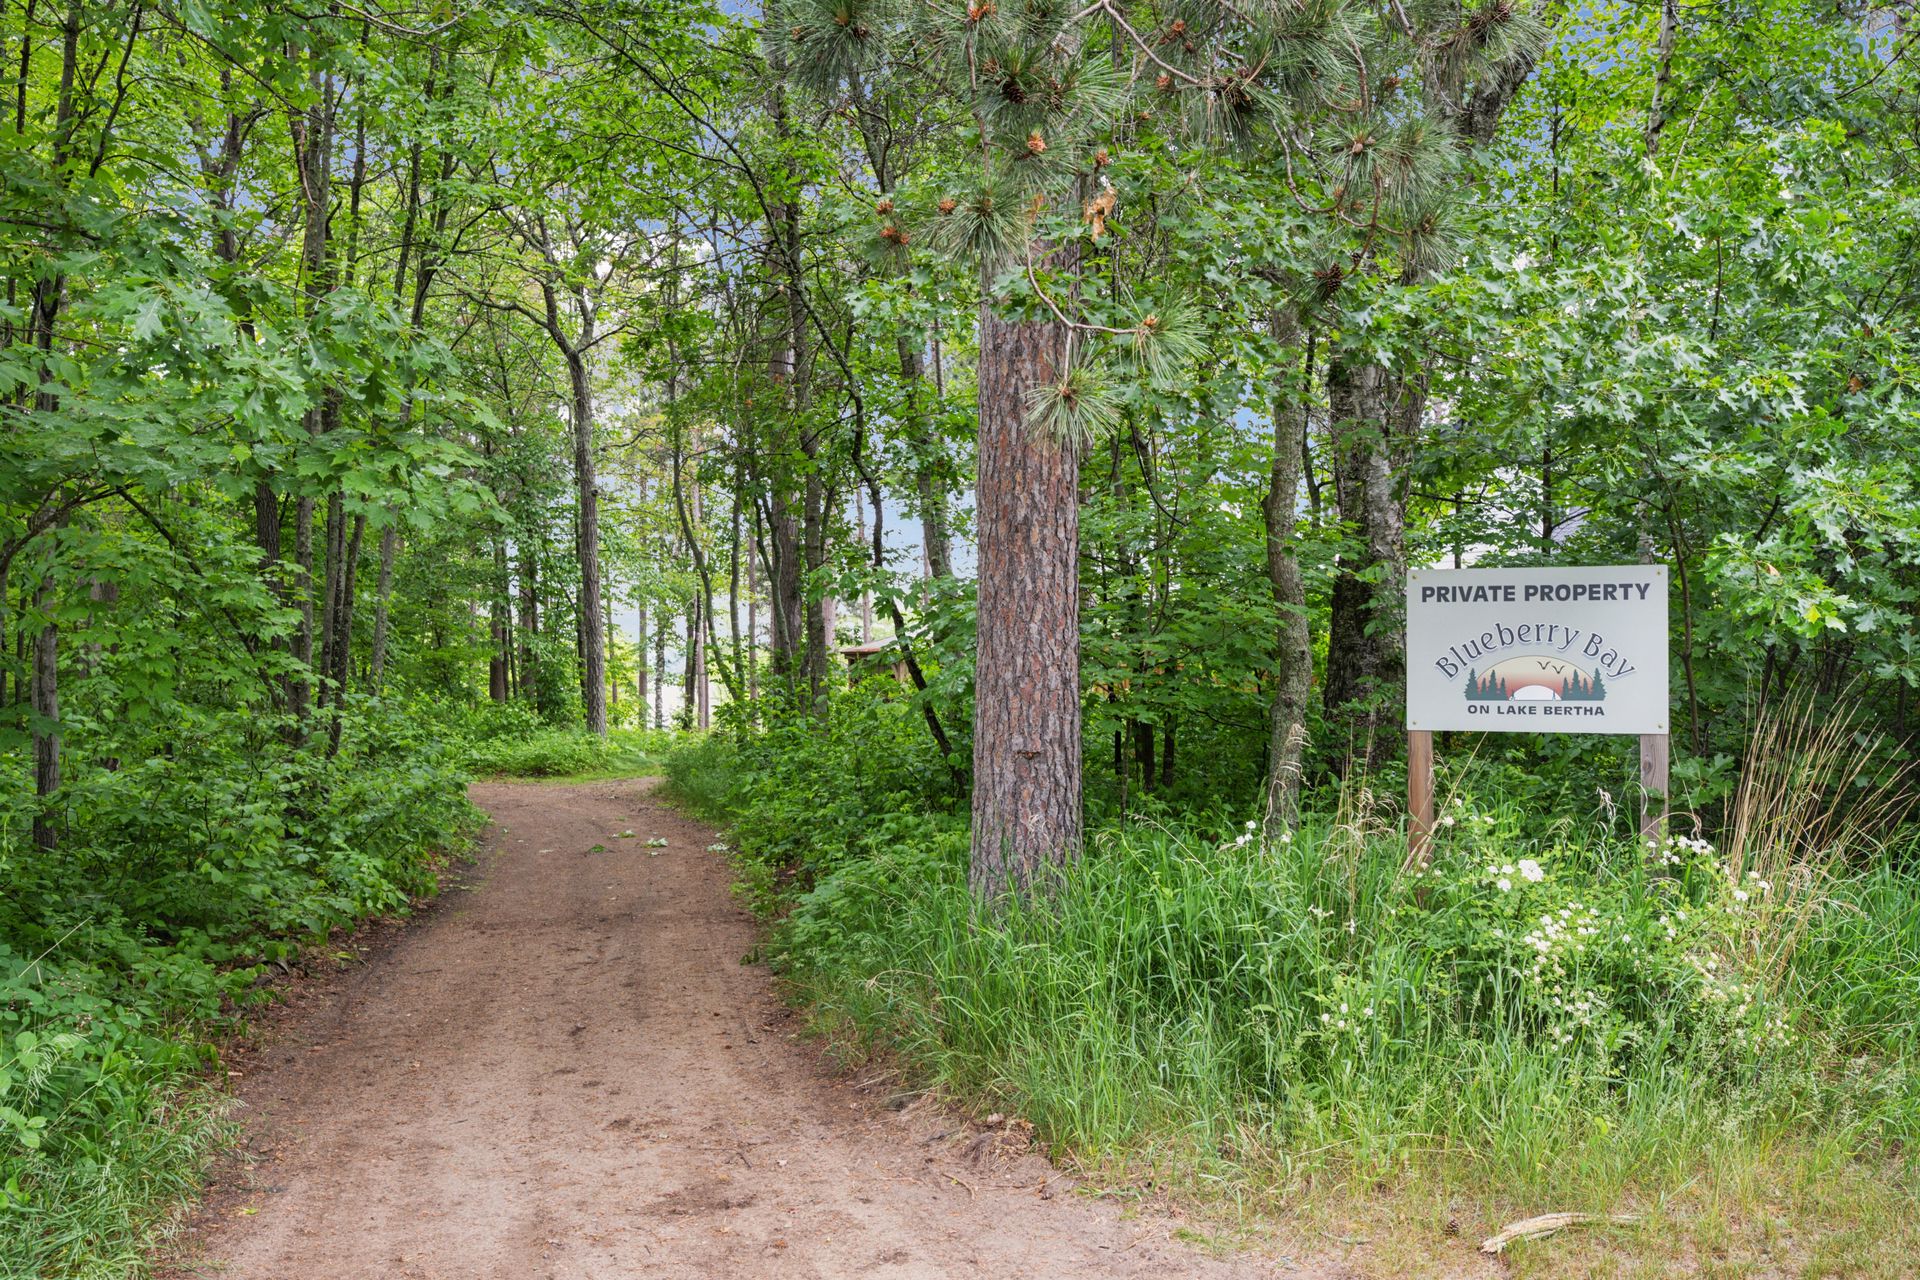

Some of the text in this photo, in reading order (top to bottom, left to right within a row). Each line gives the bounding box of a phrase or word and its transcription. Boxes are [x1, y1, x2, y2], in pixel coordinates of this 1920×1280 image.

[1421, 583, 1650, 602] PRIVATE PROPERTY
[1435, 622, 1635, 679] Blueberry Bay
[1467, 704, 1605, 716] ON LAKE BERTHA
